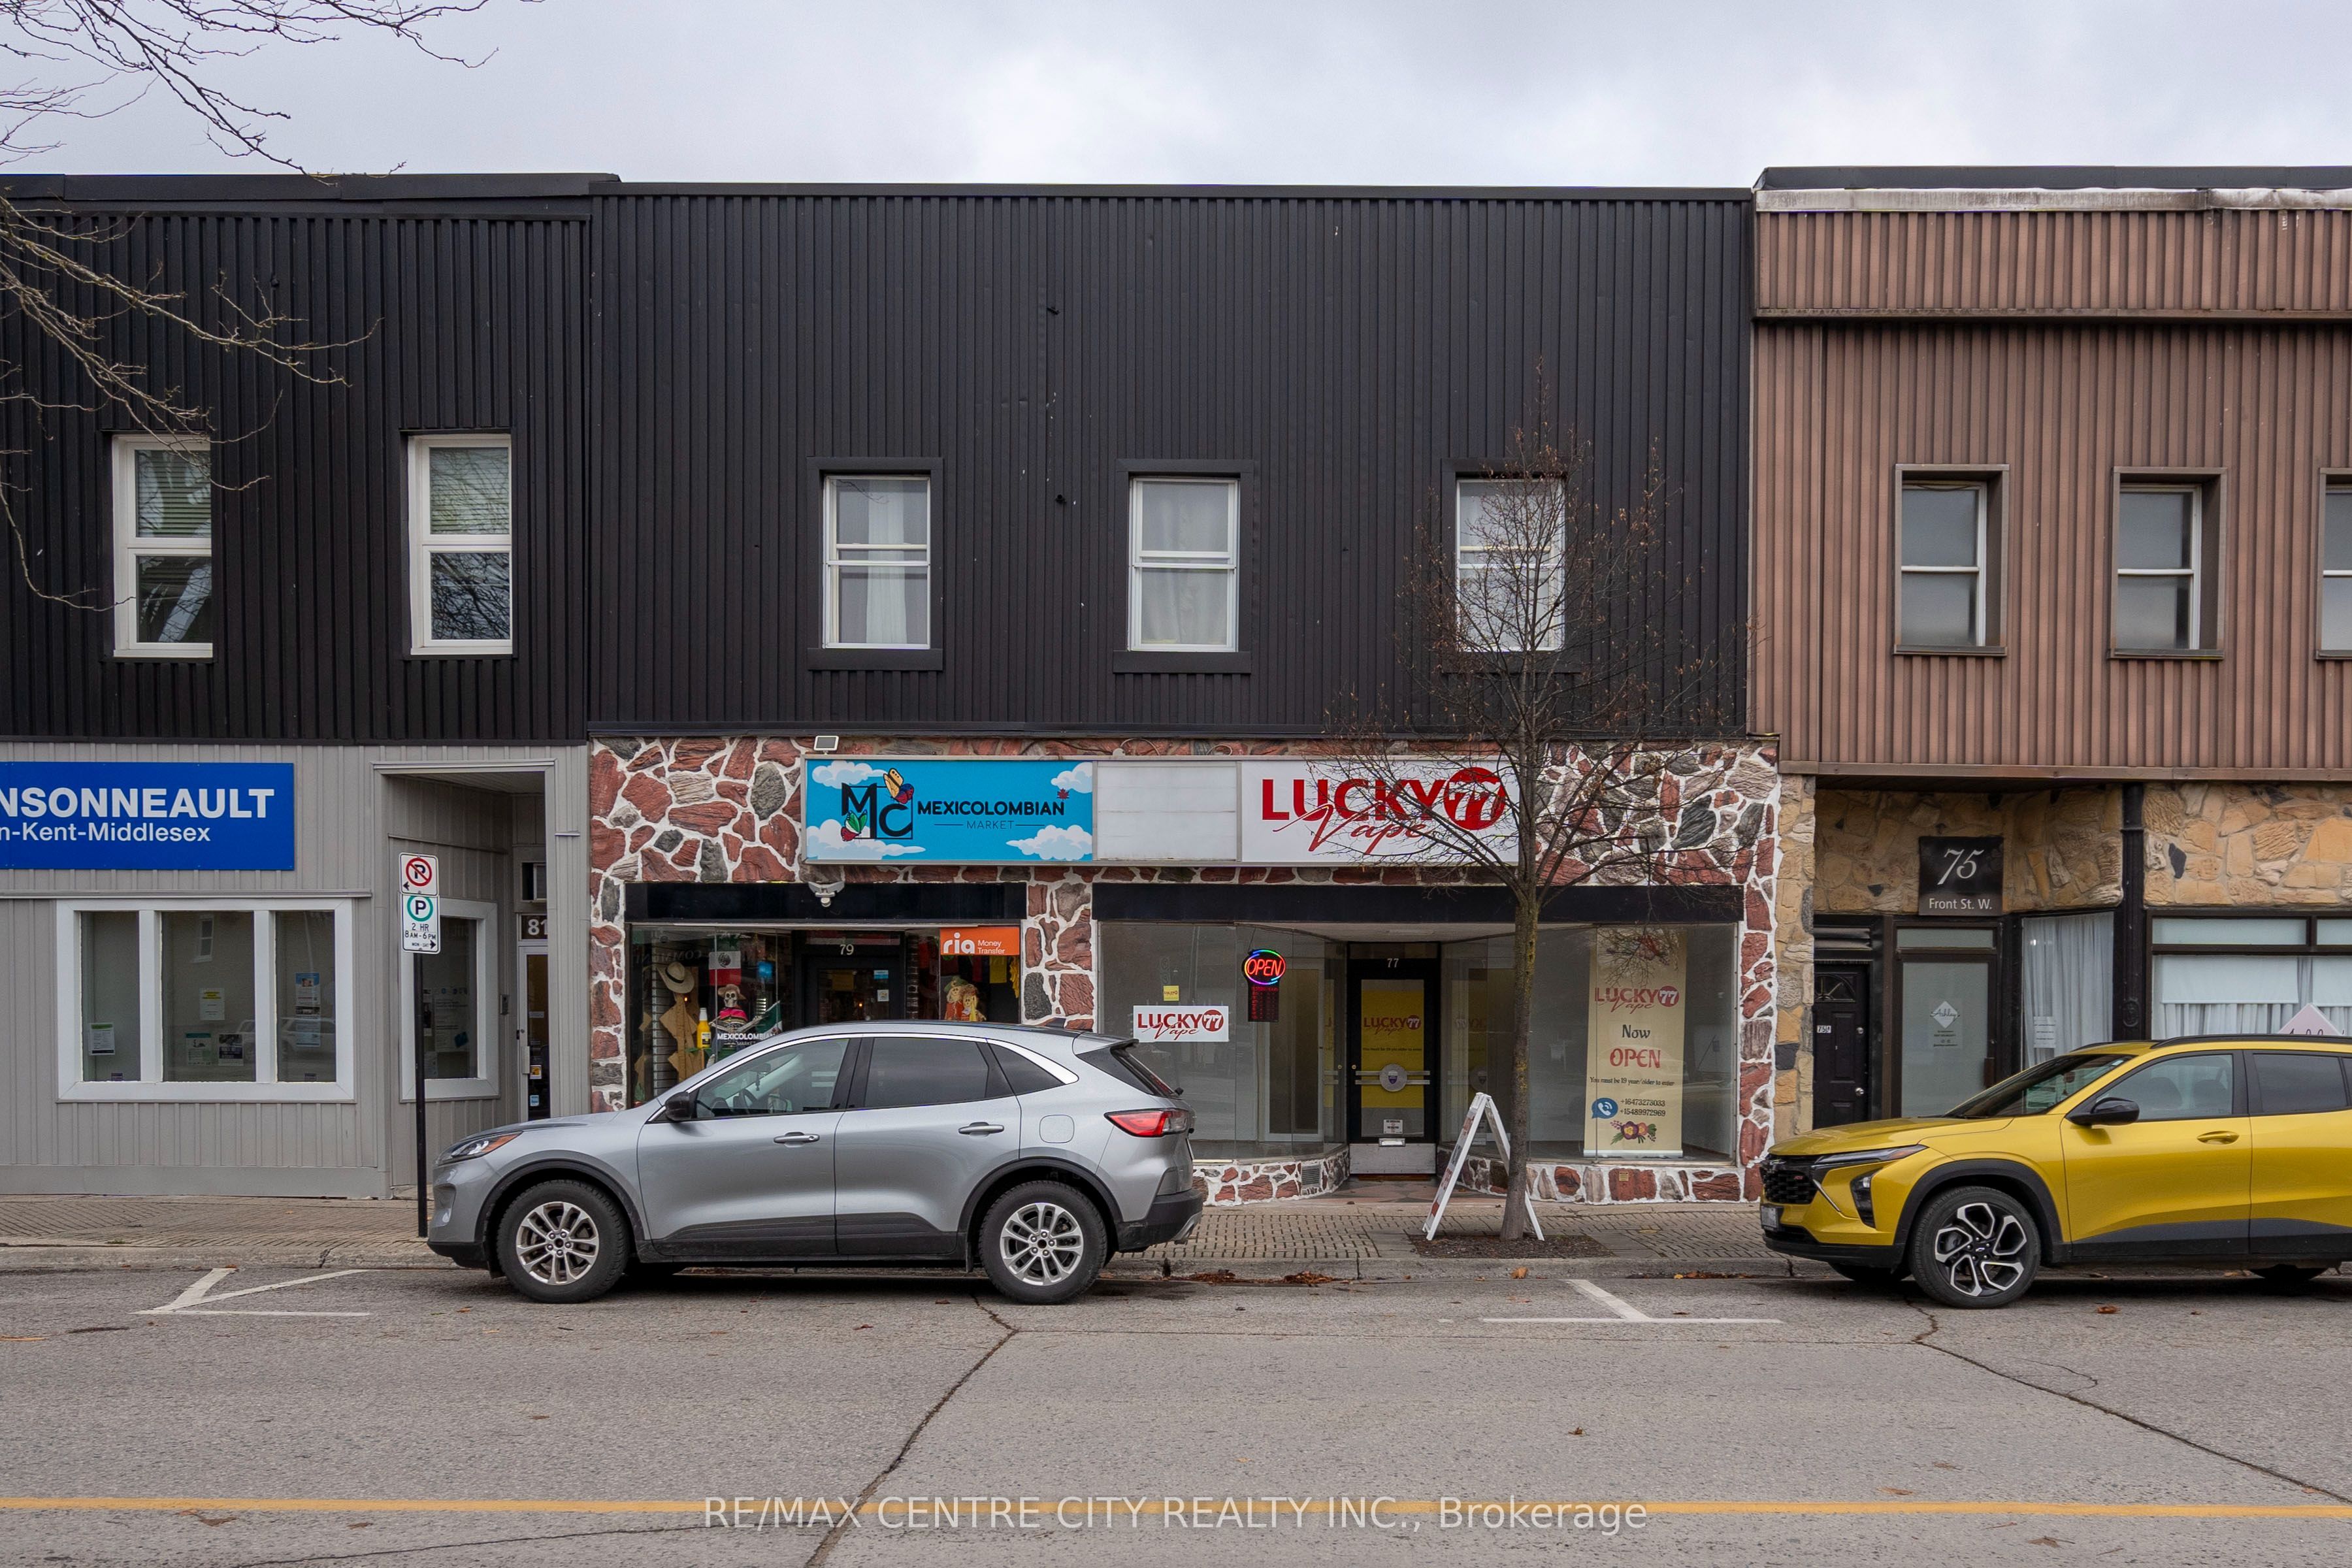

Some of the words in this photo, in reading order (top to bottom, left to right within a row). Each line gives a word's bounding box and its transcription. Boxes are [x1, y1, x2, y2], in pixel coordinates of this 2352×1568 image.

[0, 787, 275, 819] NSONNEAULT
[917, 800, 1065, 816] MEXICOLOMBIAN
[1262, 779, 1446, 821] LUCKY
[966, 820, 1015, 830] MARKET
[1273, 802, 1436, 855] Vape
[1936, 849, 1985, 885] 75
[416, 900, 427, 915] P
[1929, 898, 1957, 909] Front
[1960, 898, 1974, 909] St.
[1978, 898, 1992, 909] W.
[412, 923, 416, 931] 2
[420, 923, 429, 932] HR
[840, 944, 855, 955] 79
[1247, 958, 1282, 977] OPEN
[1386, 958, 1399, 968] 77
[1594, 987, 1659, 1003] LUCKY
[1659, 990, 1678, 1004] 77
[1598, 996, 1656, 1015] Vape
[1137, 1013, 1203, 1029] LUCKY
[1203, 1014, 1222, 1029] 77
[1364, 1017, 1407, 1028] LUCKY
[1407, 1018, 1420, 1028] 77
[1141, 1021, 1200, 1040] Vape
[1622, 1024, 1651, 1039] Now
[1610, 1048, 1661, 1068] OPEN
